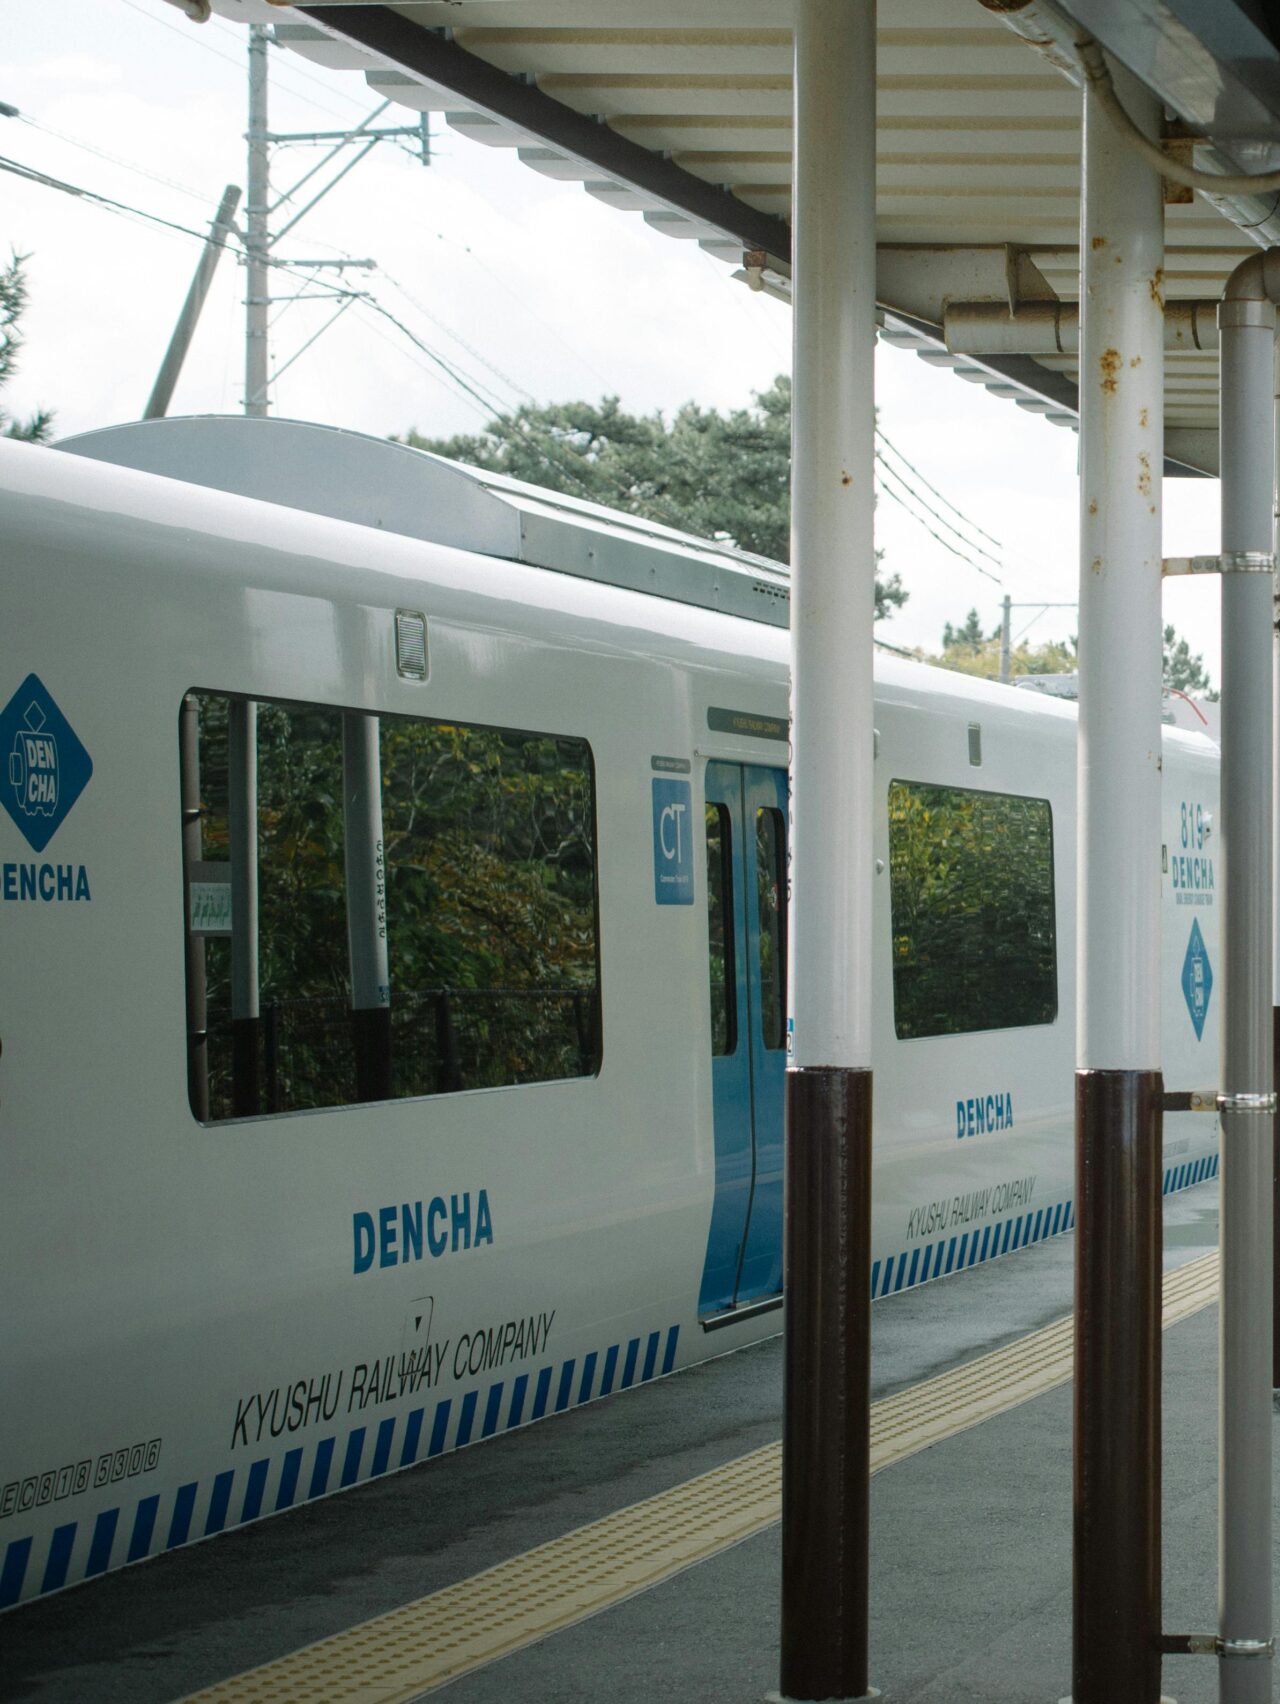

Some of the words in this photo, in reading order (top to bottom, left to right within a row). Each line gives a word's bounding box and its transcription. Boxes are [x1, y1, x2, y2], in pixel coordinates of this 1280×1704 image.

[26, 739, 56, 770] DEN
[28, 773, 57, 803] CHA
[660, 803, 686, 864] CT
[1181, 801, 1204, 850] 819
[0, 863, 92, 902] ENCHA
[1172, 856, 1215, 890] DENCHA
[956, 1092, 1013, 1139] DENCHA
[906, 1199, 951, 1240] KYUSHU
[950, 1187, 994, 1227] RAILWAY
[991, 1175, 1037, 1215] COMPANY
[353, 1188, 494, 1275] DENCHA
[230, 1370, 343, 1450] KYUSHU
[347, 1340, 449, 1414] RAILWAY
[453, 1309, 556, 1381] COMPANY
[96, 1443, 158, 1483] 5306
